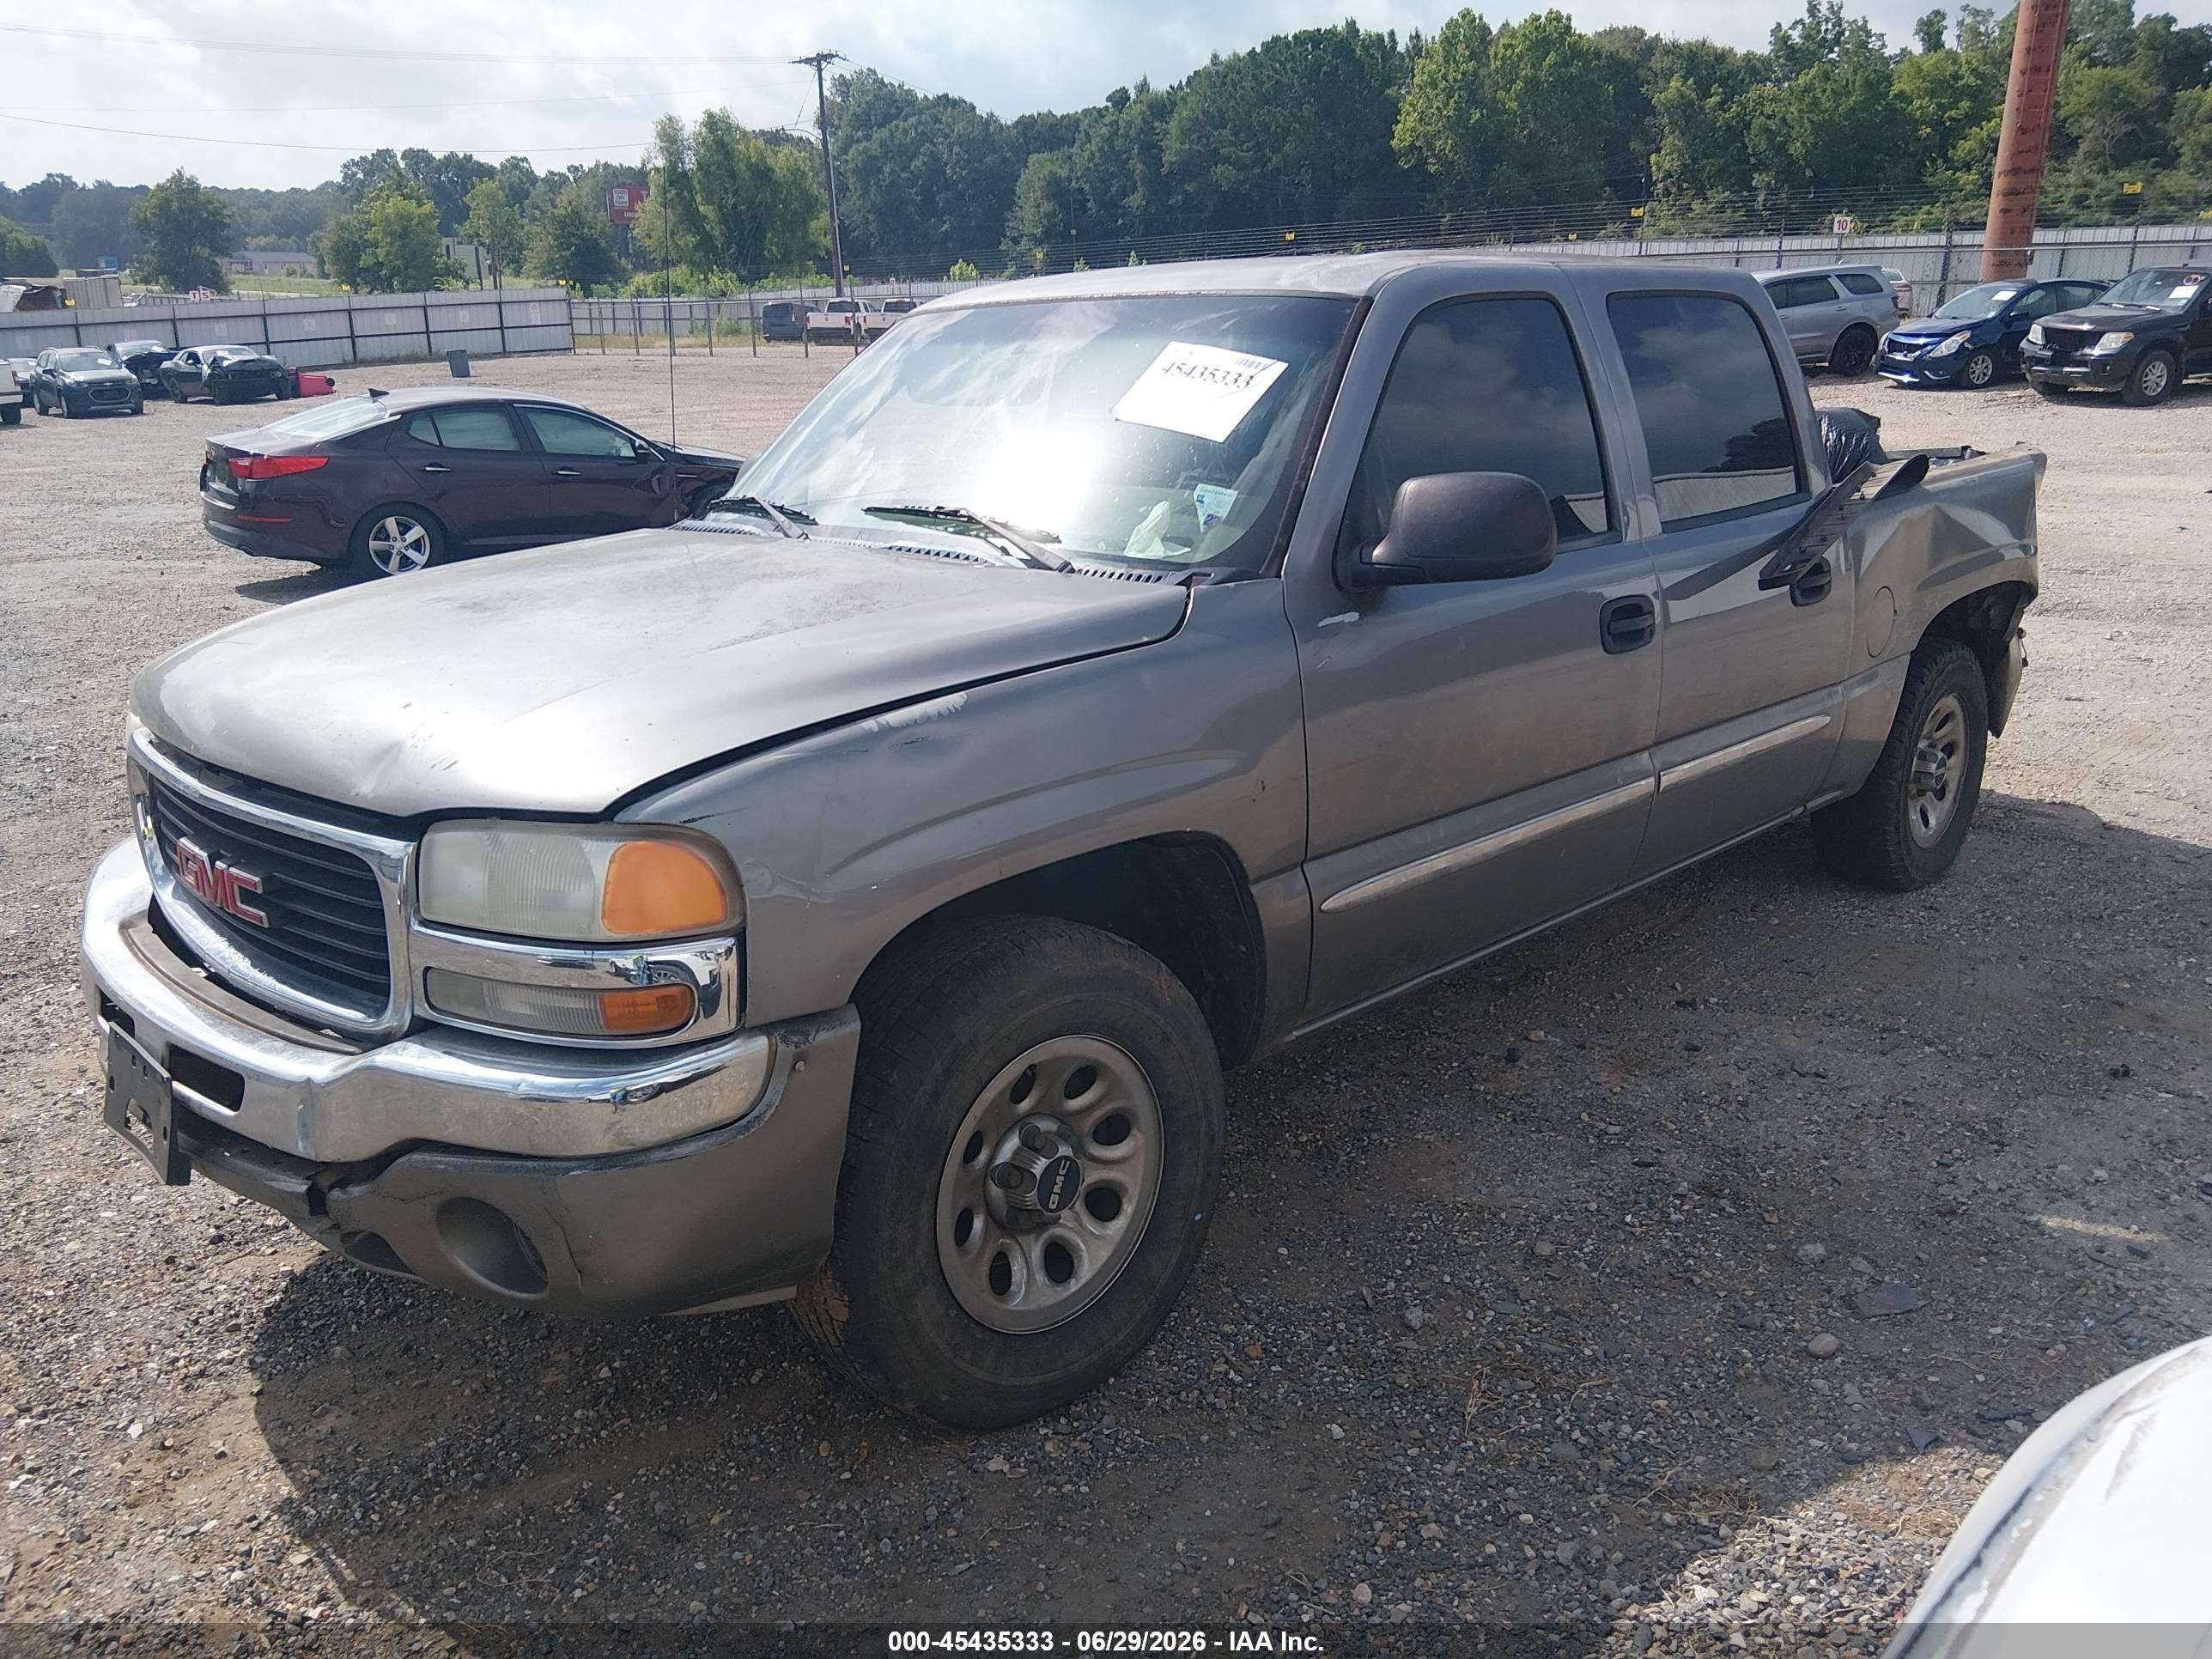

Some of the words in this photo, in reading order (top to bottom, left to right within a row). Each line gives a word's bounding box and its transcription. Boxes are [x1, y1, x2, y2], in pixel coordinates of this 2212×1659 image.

[1836, 219, 1849, 231] 10
[202, 291, 210, 300] S
[1161, 361, 1255, 389] 45435333
[177, 836, 270, 928] GMC
[1048, 1159, 1071, 1210] GMC
